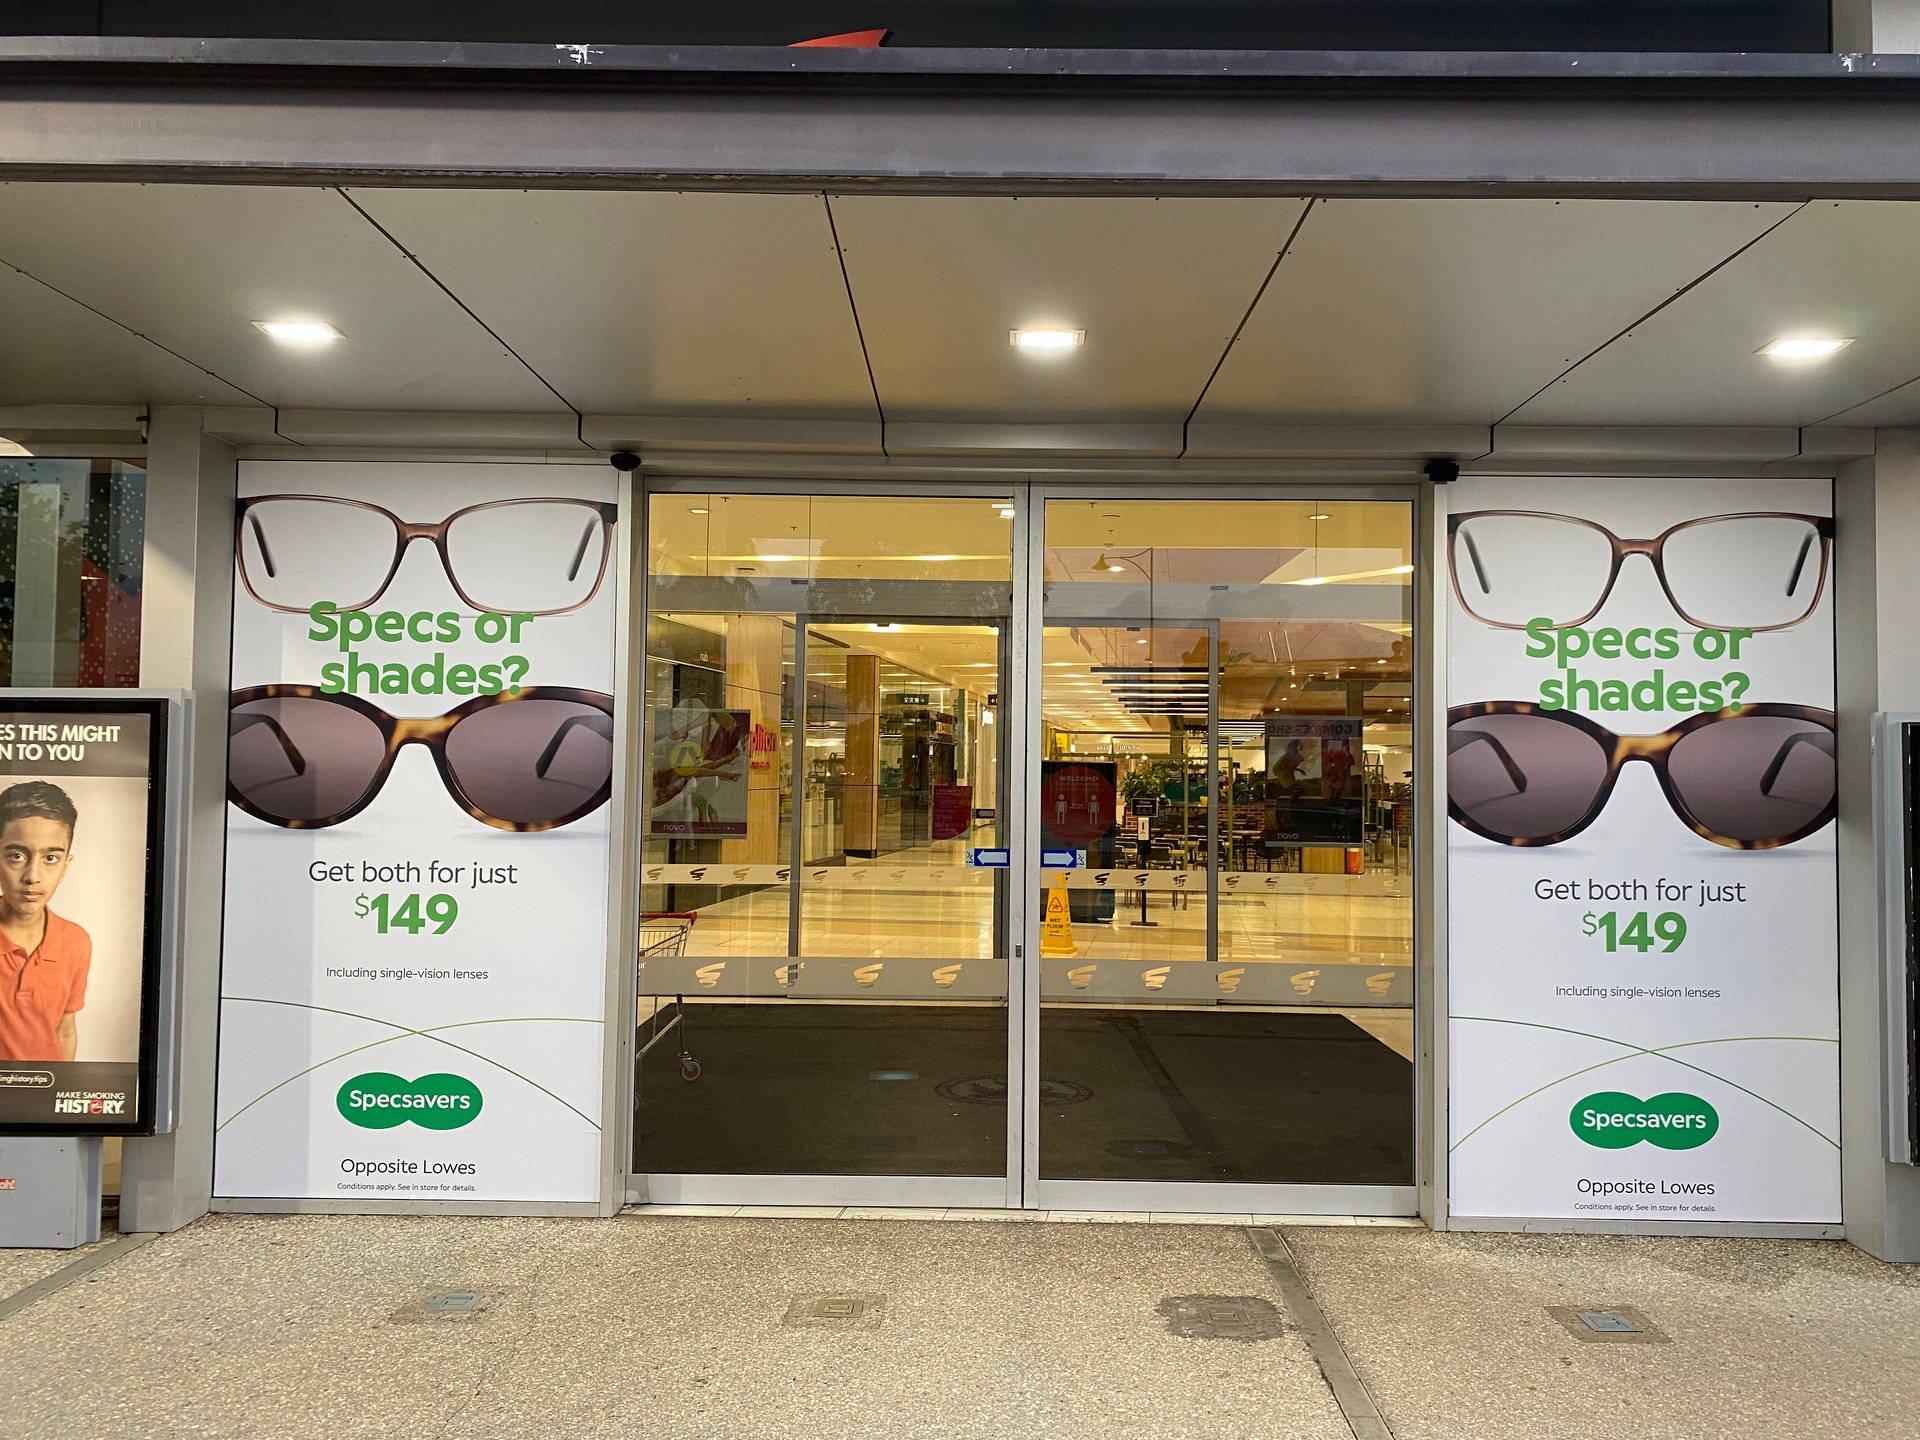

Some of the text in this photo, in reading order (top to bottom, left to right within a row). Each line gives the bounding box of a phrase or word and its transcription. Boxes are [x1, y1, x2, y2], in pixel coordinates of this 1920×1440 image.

[308, 601, 534, 652] Specs or
[1525, 618, 1753, 668] Specs or
[320, 652, 530, 696] shades?
[1539, 669, 1750, 712] shades?
[19, 724, 58, 742] THIS
[61, 724, 121, 742] MIGHT
[16, 743, 43, 761] TO
[46, 744, 85, 761] YOU
[663, 823, 685, 831] novo
[1277, 832, 1299, 840] novo
[309, 860, 518, 889] Get both for just
[1534, 878, 1746, 907] Get both for just
[354, 892, 458, 935] $149
[1582, 910, 1687, 953] $149
[326, 967, 489, 980] Including single-vision lenses
[1556, 985, 1721, 999] Including single-vision lenses
[56, 1091, 125, 1100] MAKE SMOKING
[349, 1090, 470, 1111] Specsavers
[1582, 1109, 1706, 1130] Specsavers
[341, 1158, 476, 1176] Opposite Lowes
[337, 1182, 374, 1190] Conditions
[376, 1184, 396, 1192] apply.
[398, 1183, 411, 1191] See
[1577, 1178, 1715, 1196] Opposite Lowes
[1574, 1202, 1717, 1212] Conditions apply. See in store for details.
